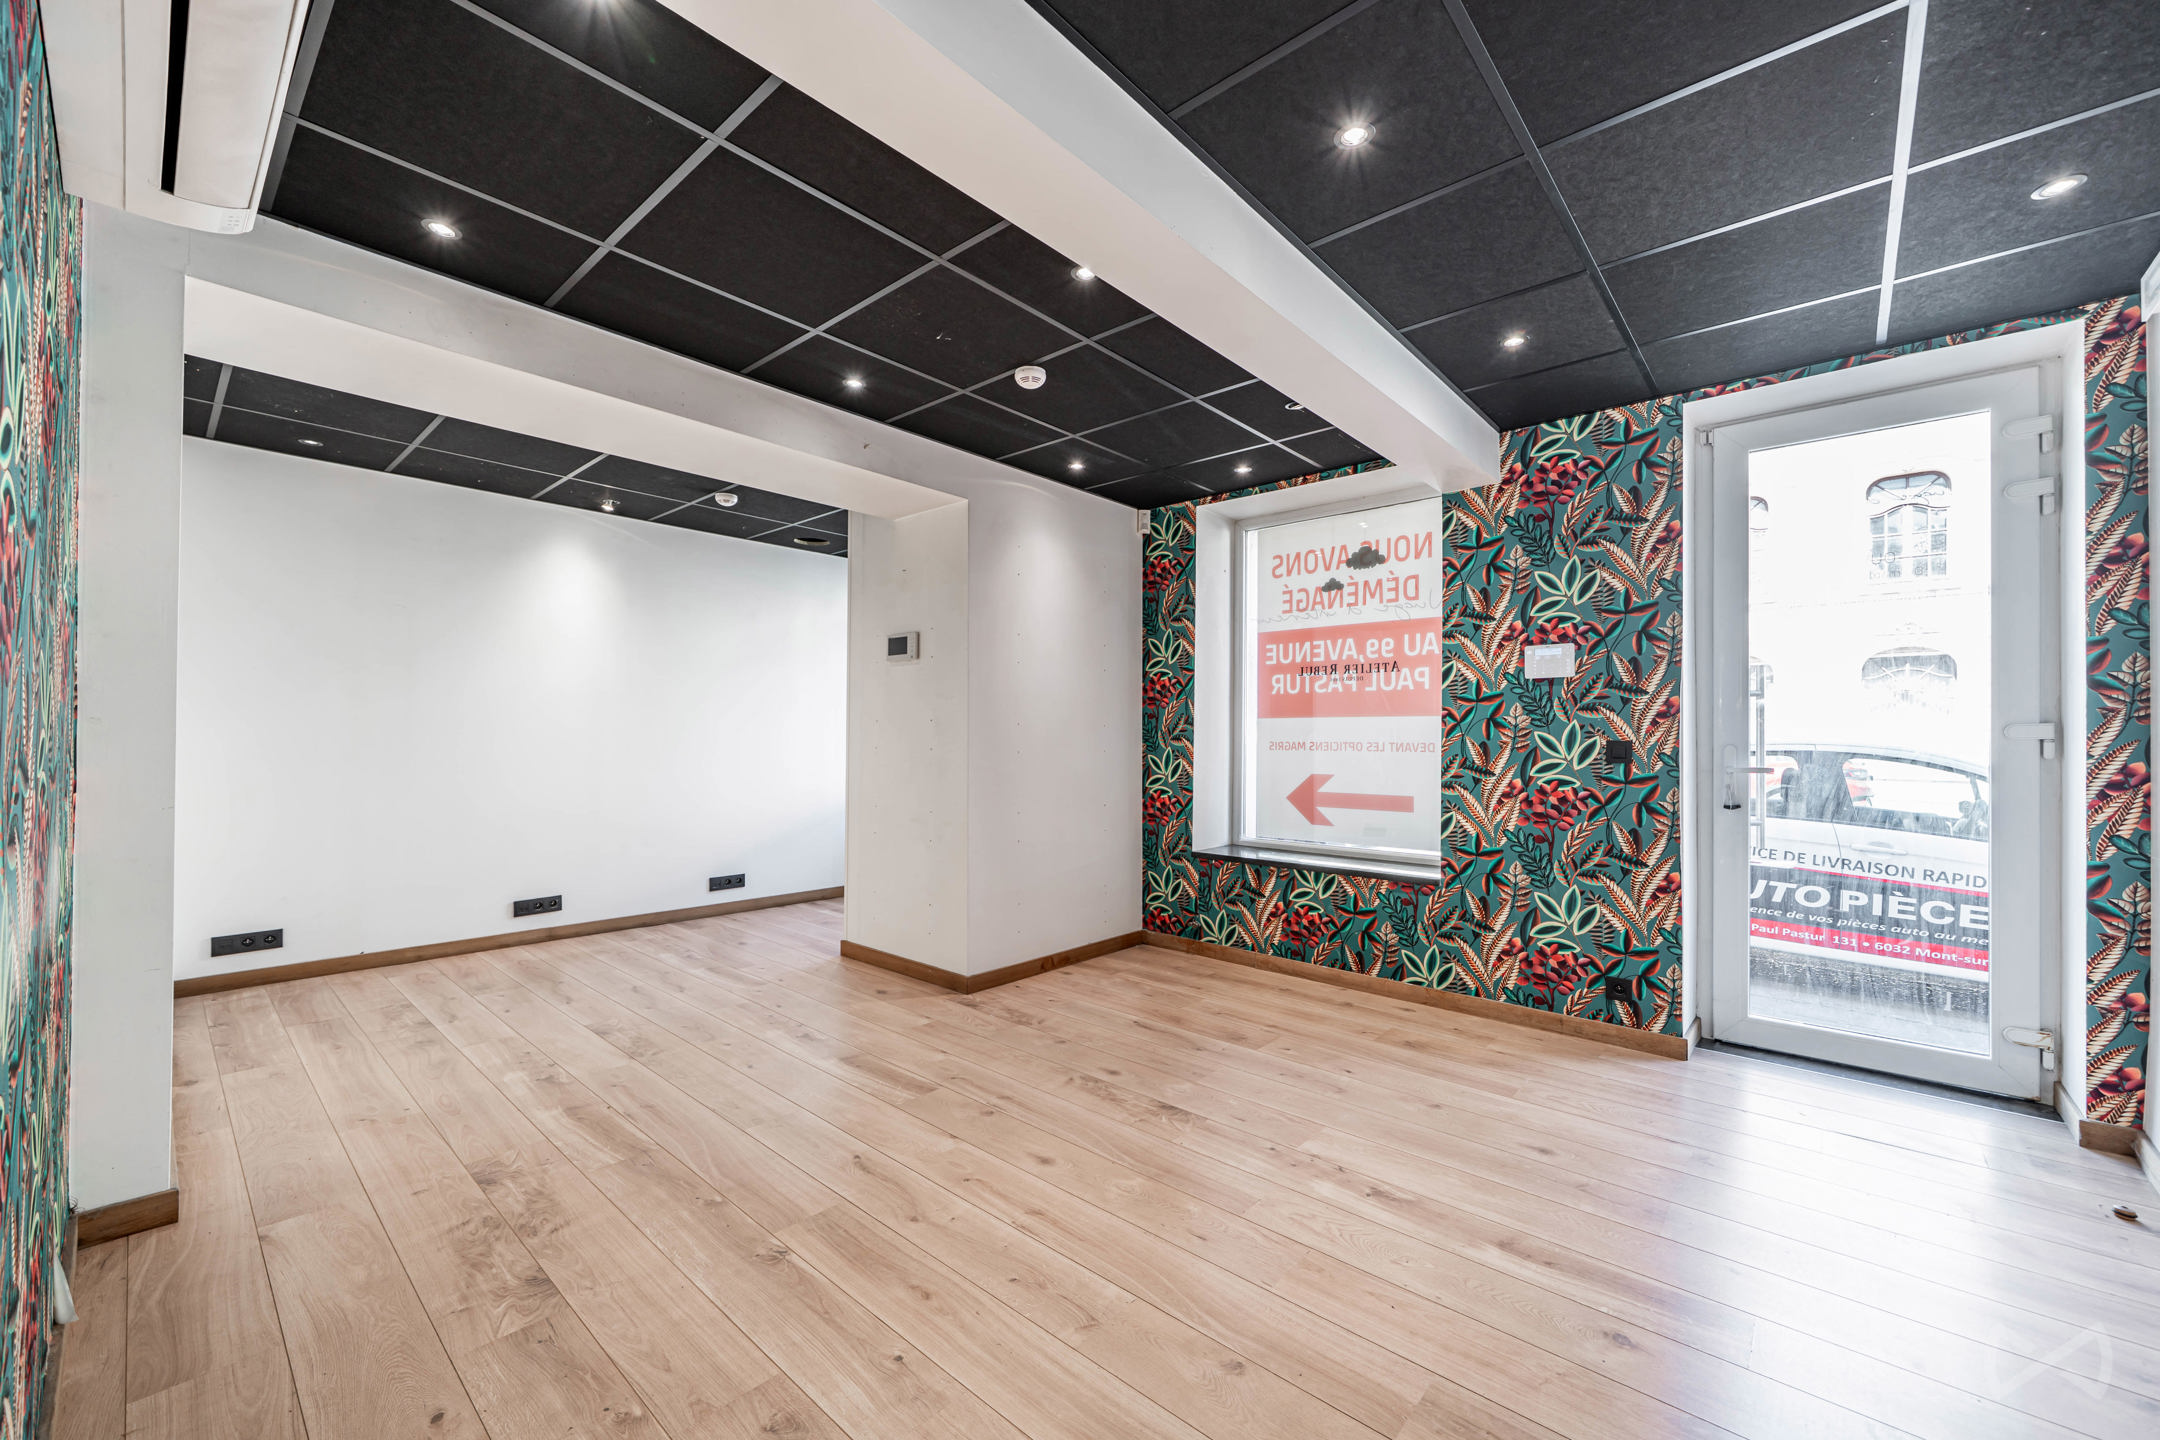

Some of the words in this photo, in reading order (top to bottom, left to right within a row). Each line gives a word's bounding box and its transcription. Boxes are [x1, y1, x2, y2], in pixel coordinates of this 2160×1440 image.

[1783, 850, 1807, 864] DE
[1812, 854, 1915, 879] LIVRAISON
[1922, 868, 1987, 889] RAPID
[1786, 910, 1805, 920] de
[1808, 914, 1834, 924] vos
[1836, 918, 1887, 931] pièces
[1890, 925, 1930, 937] auto
[1934, 932, 1957, 941] au
[1960, 936, 1989, 946] me
[1839, 889, 1989, 931] PIÈCE
[1751, 923, 1779, 935] Paul
[1782, 928, 1825, 941] Pastur
[1832, 935, 1858, 947] 131
[1874, 942, 1911, 955] 6032
